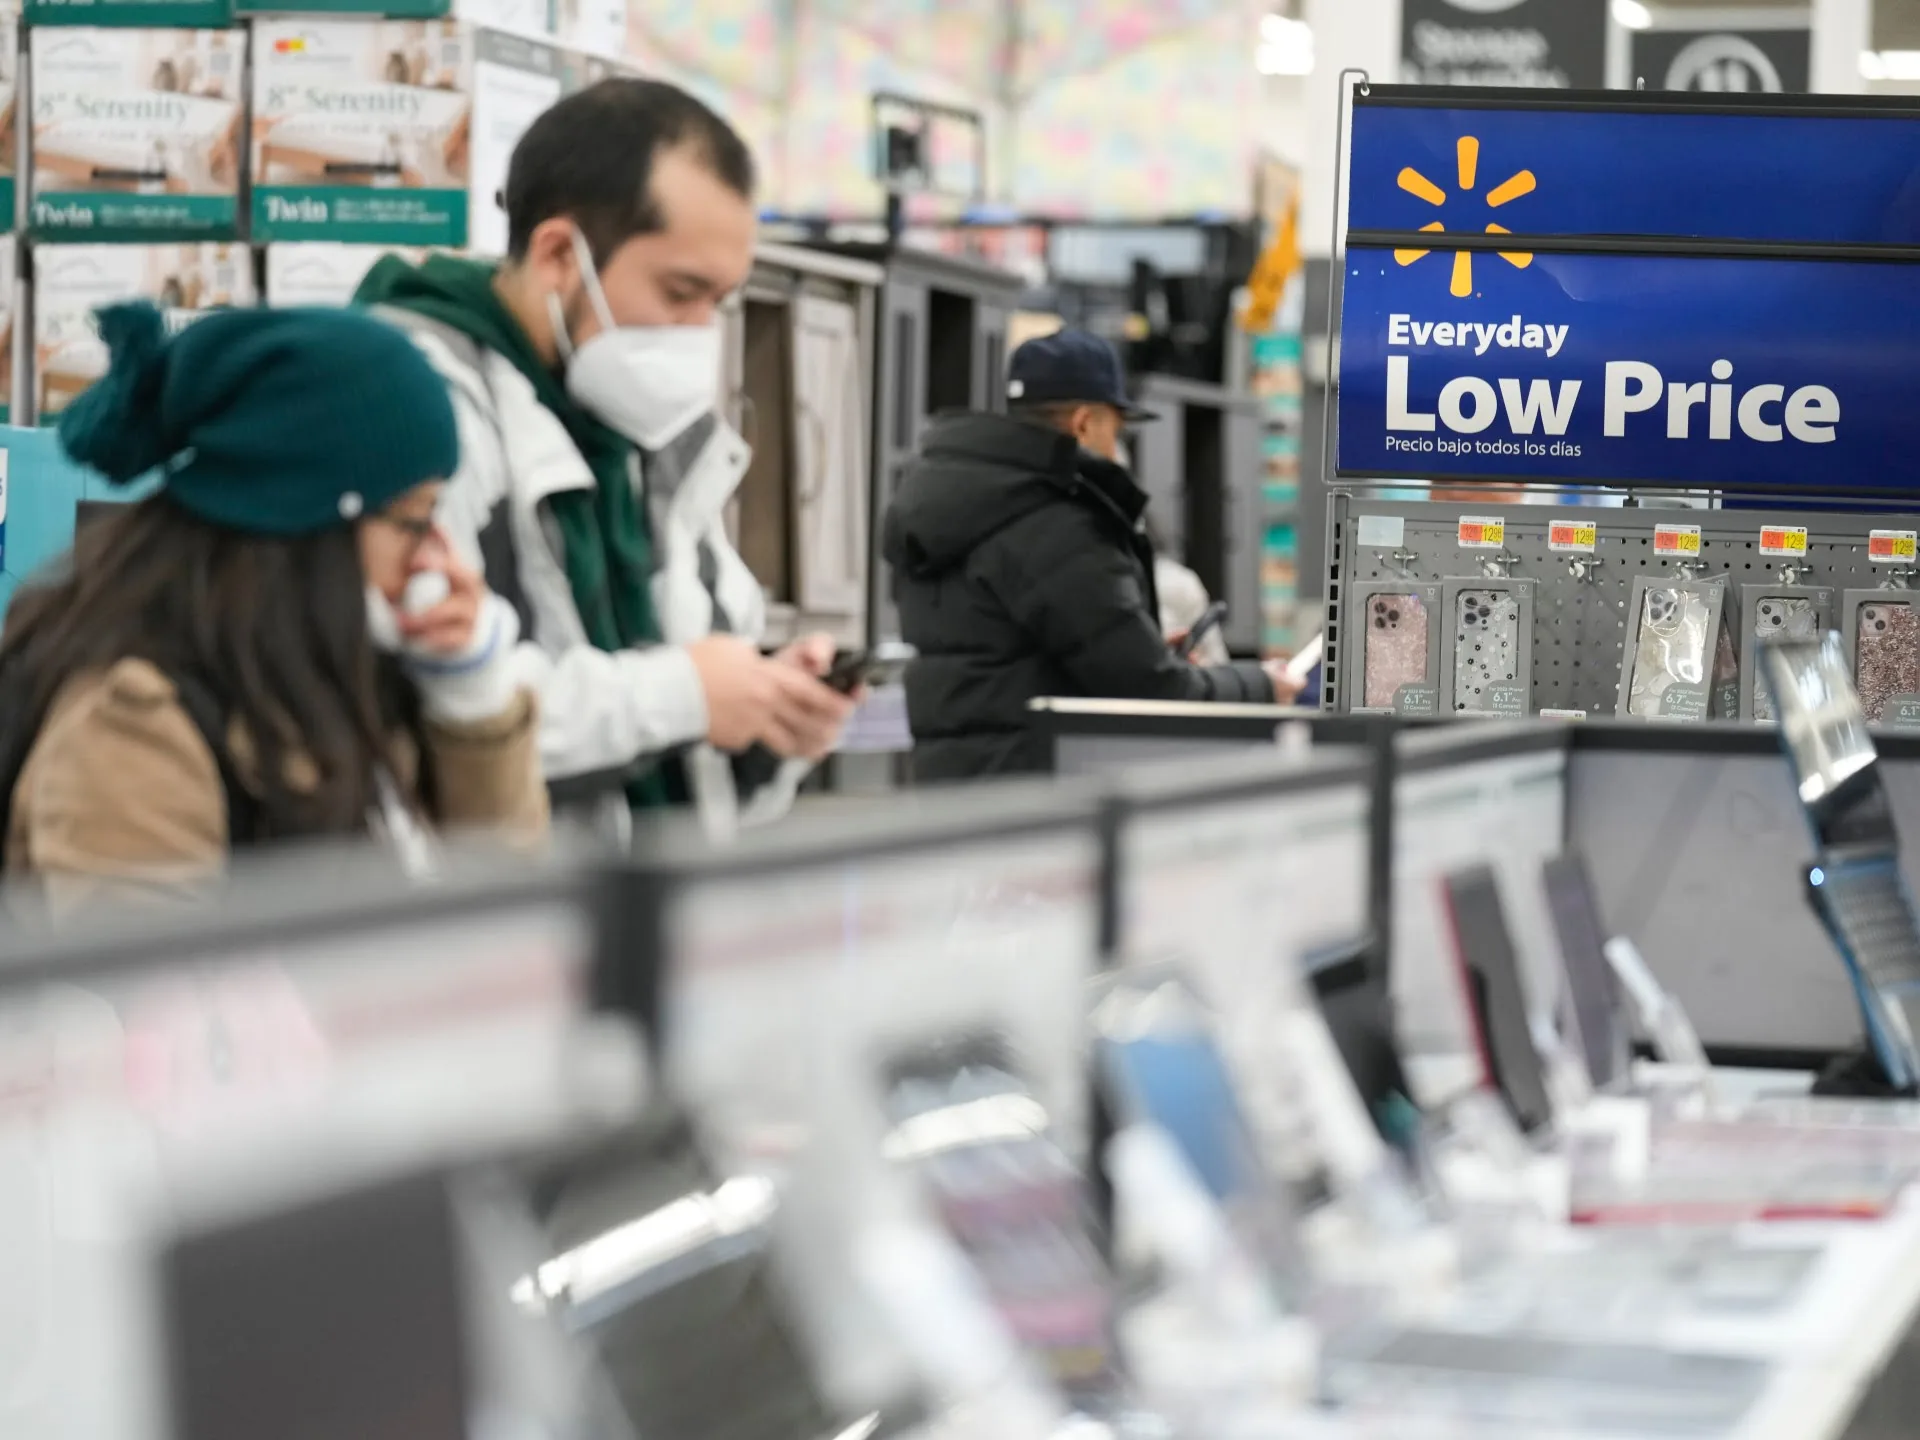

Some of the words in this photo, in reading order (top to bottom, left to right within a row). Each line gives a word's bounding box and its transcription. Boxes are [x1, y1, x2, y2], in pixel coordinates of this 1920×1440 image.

[74, 94, 190, 126] Serenity
[306, 87, 422, 116] Serenity
[264, 194, 328, 222] Twin
[1388, 313, 1569, 358] Everyday
[1386, 355, 1582, 436] Low
[1603, 358, 1841, 444] Price
[1385, 436, 1433, 453] Precio
[1437, 437, 1472, 457] bajo
[1475, 439, 1520, 455] todos
[1524, 440, 1546, 456] los
[1549, 441, 1582, 457] días
[1493, 692, 1513, 702] 6.1"
[1666, 693, 1687, 704] 6.7"
